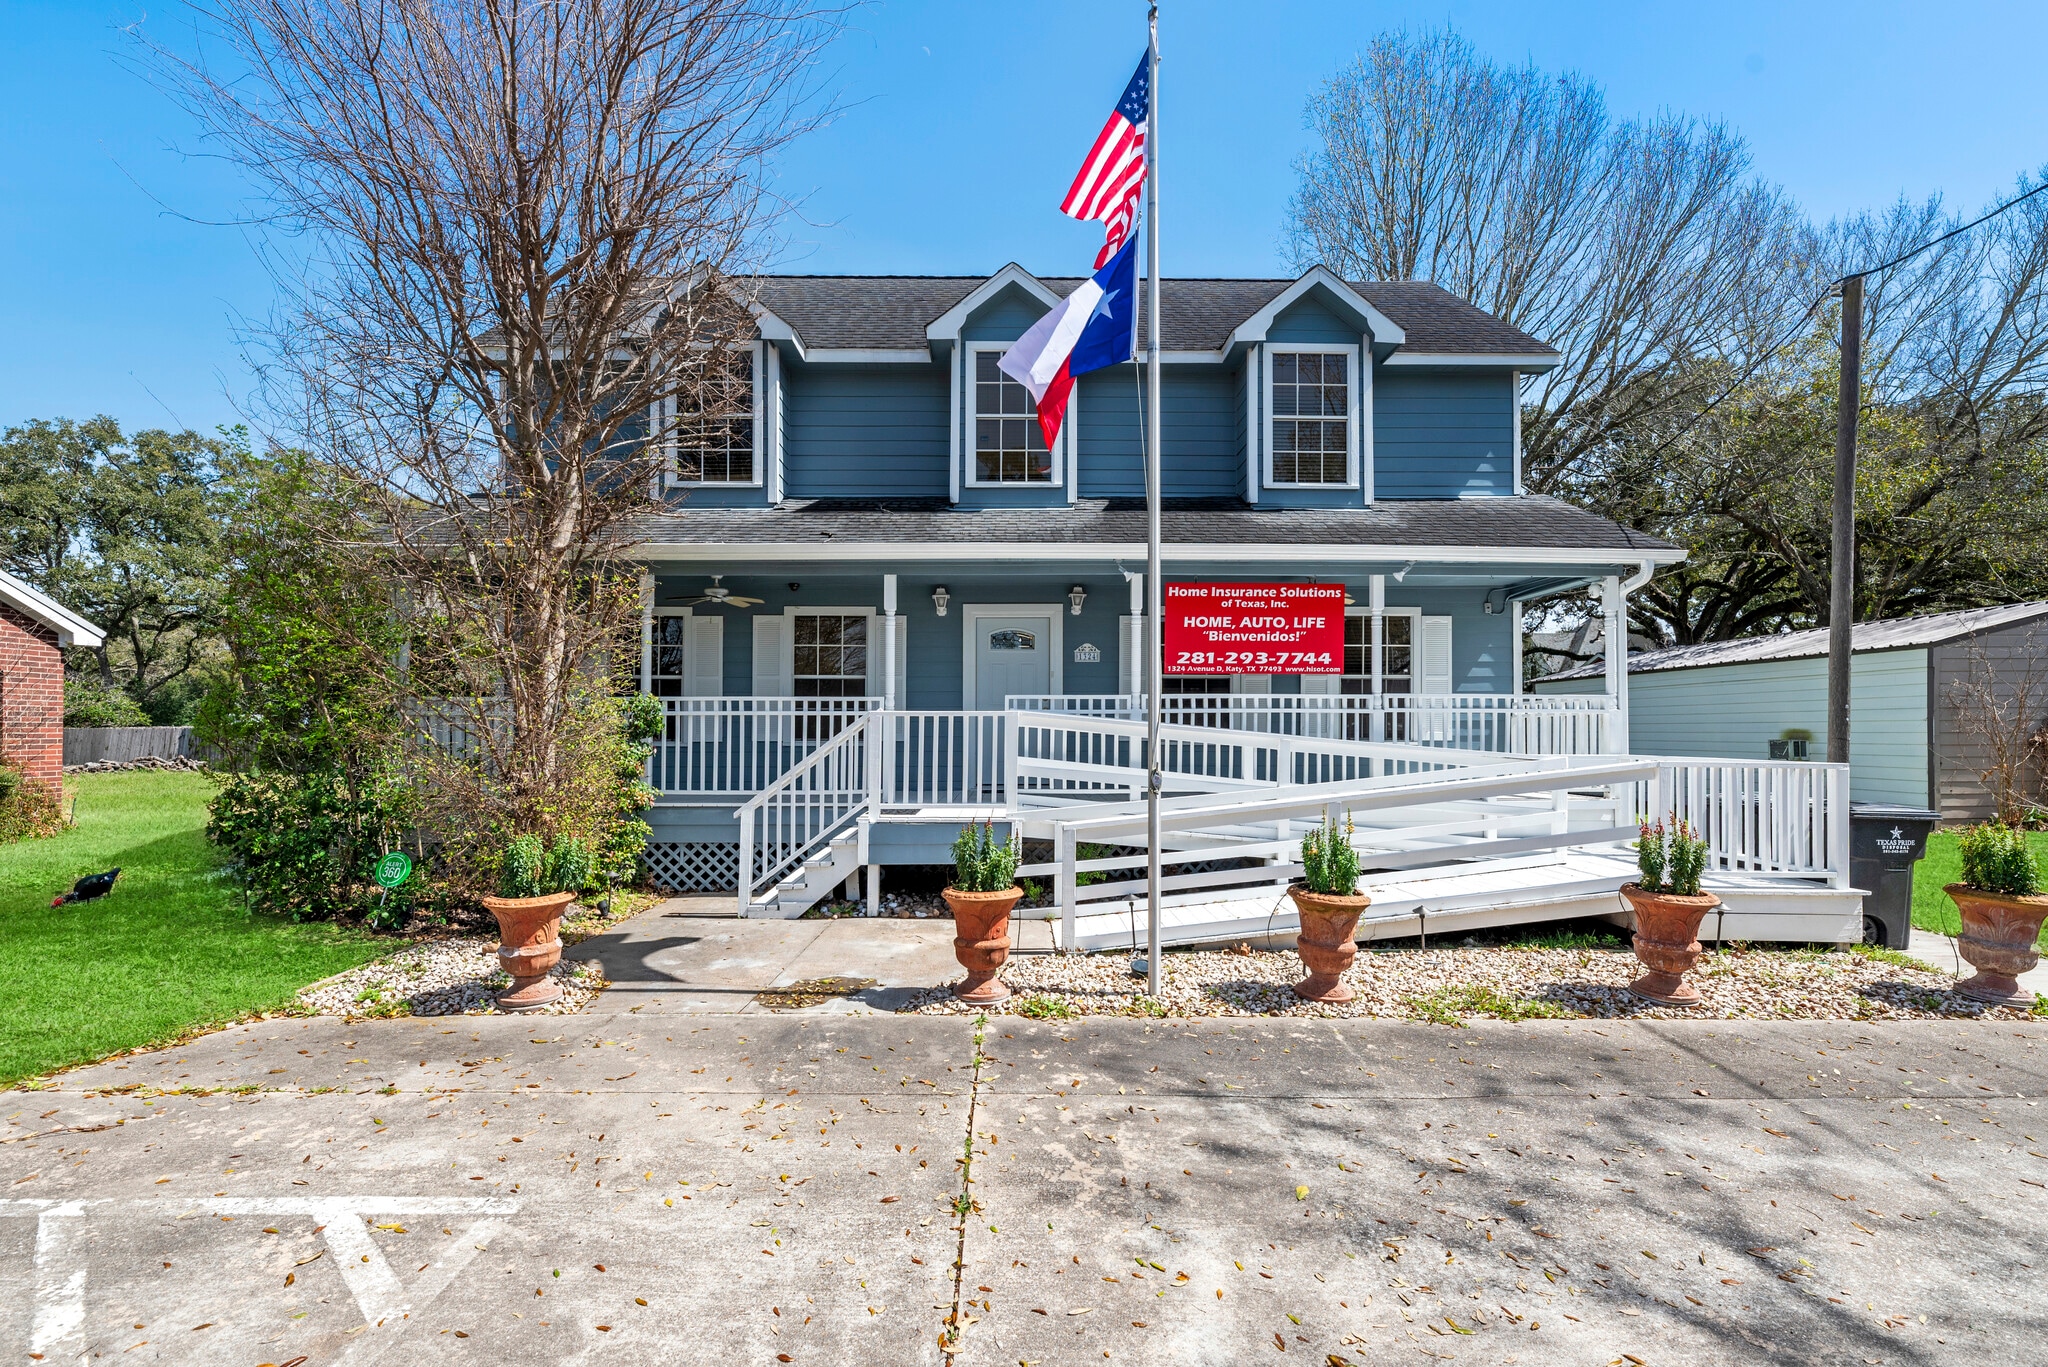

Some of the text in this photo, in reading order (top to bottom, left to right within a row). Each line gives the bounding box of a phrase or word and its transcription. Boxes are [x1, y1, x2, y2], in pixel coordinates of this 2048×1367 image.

[1168, 586, 1341, 598] Home Insurance Solutions
[1221, 599, 1290, 609] of Texas, Inc.
[1183, 616, 1326, 629] HOME, AUTO, LIFE
[1176, 651, 1332, 665] 281-293-7744
[1216, 665, 1225, 673] D,
[1225, 665, 1245, 673] Katy,
[382, 866, 401, 878] 360
